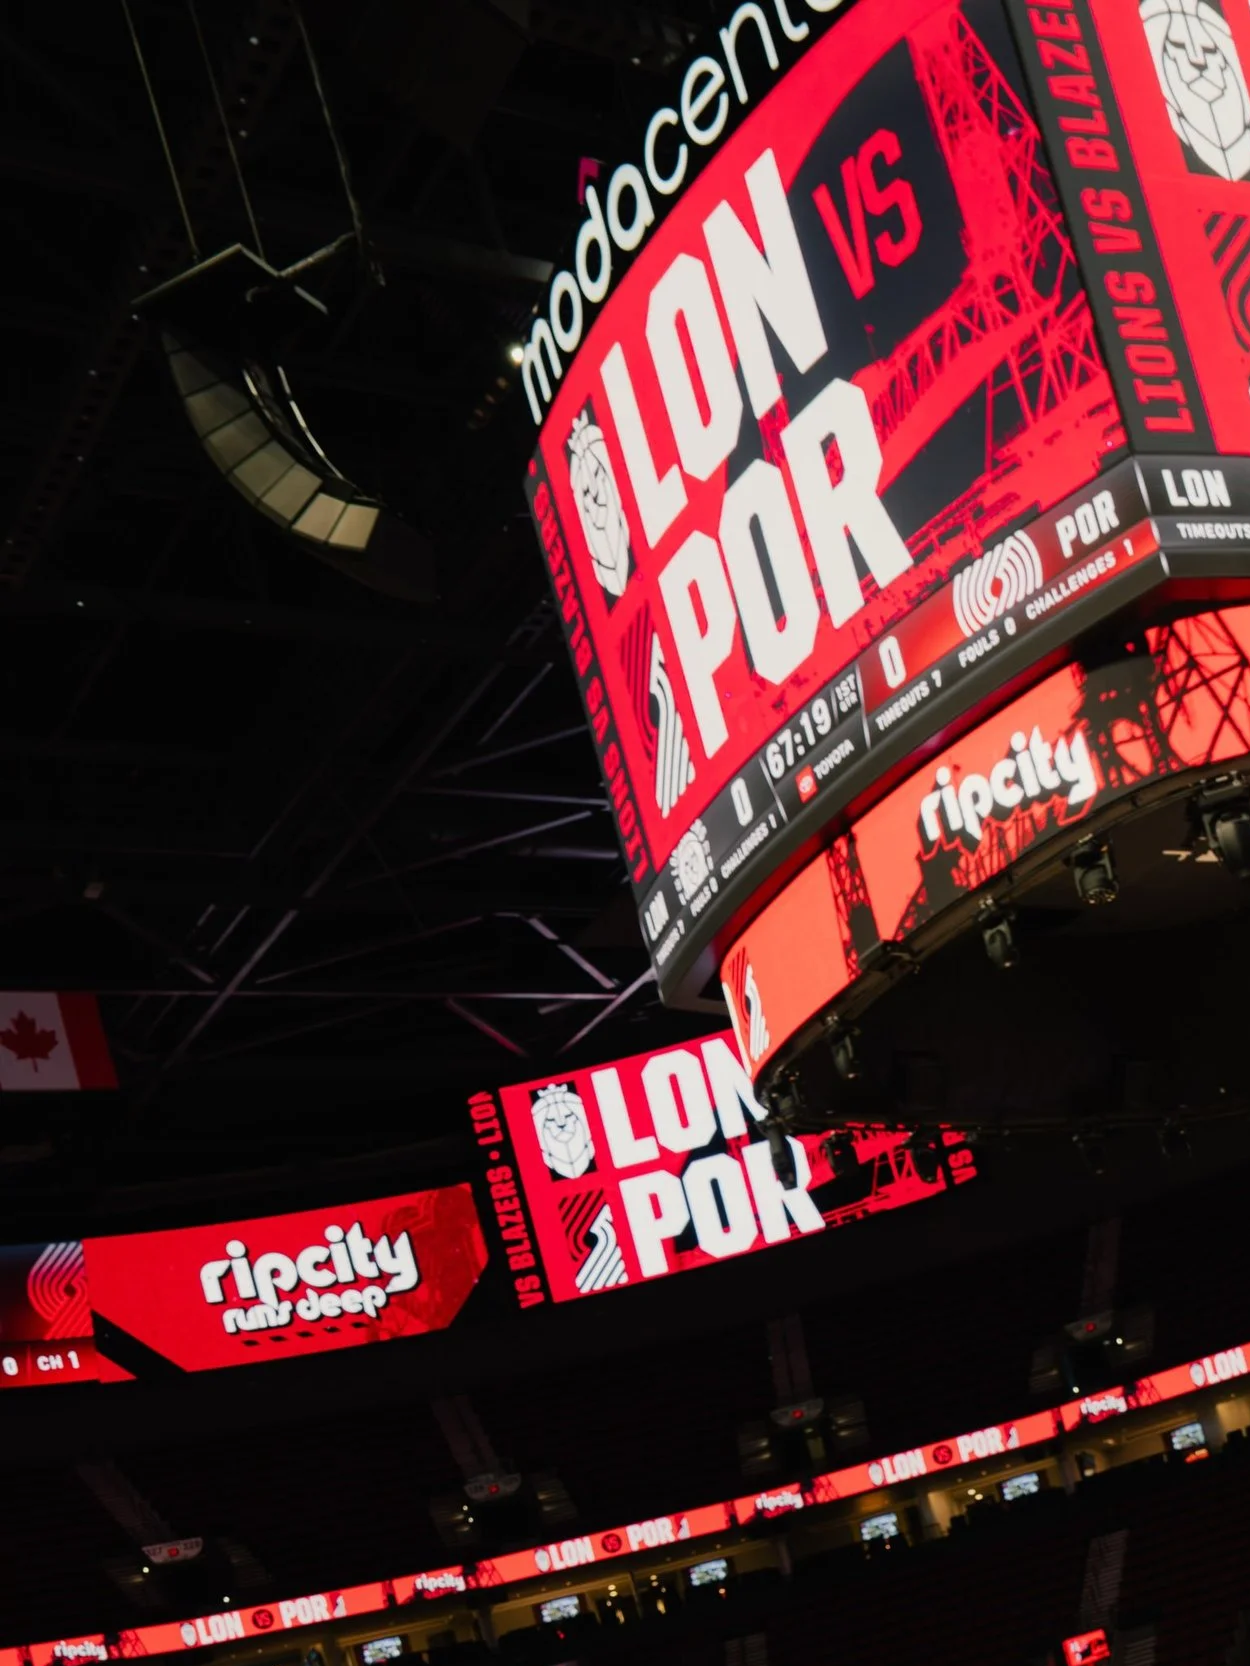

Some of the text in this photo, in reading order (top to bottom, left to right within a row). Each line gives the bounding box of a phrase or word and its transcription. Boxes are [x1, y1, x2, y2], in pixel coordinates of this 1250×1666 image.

[812, 128, 922, 299] VS
[1027, 0, 1195, 434] LIONS VS BLAZE
[600, 147, 828, 549] LON
[1161, 469, 1231, 508] LON
[657, 377, 915, 760] POR
[878, 490, 1120, 690] 0 POR
[534, 480, 650, 884] LIONS VS BLAZERS
[875, 679, 931, 732] TIMEOUTS
[931, 669, 943, 688] 7
[957, 628, 1001, 669] FOULS
[1024, 550, 1117, 621] CHALLENGES
[1122, 538, 1135, 557] 1
[730, 777, 754, 828] 0
[765, 697, 832, 780] 67:19
[813, 738, 855, 780] TOYOTA
[919, 726, 1098, 842] ripcity
[720, 822, 770, 880] CHALLENGES
[590, 1037, 769, 1170] LON
[486, 1165, 537, 1272] BLAZERS
[618, 1132, 827, 1279] POR
[200, 1221, 419, 1310] ripcity
[295, 1286, 387, 1321] deep
[514, 1273, 545, 1310] VS
[36, 1354, 65, 1372] CH
[67, 1350, 81, 1370] 1
[1202, 1347, 1249, 1386] LON
[881, 1449, 928, 1484] LON
[956, 1426, 1007, 1463] POR
[547, 1536, 597, 1571] LON
[626, 1516, 676, 1552] POR
[195, 1611, 245, 1645] LON
[278, 1594, 333, 1628] POR
